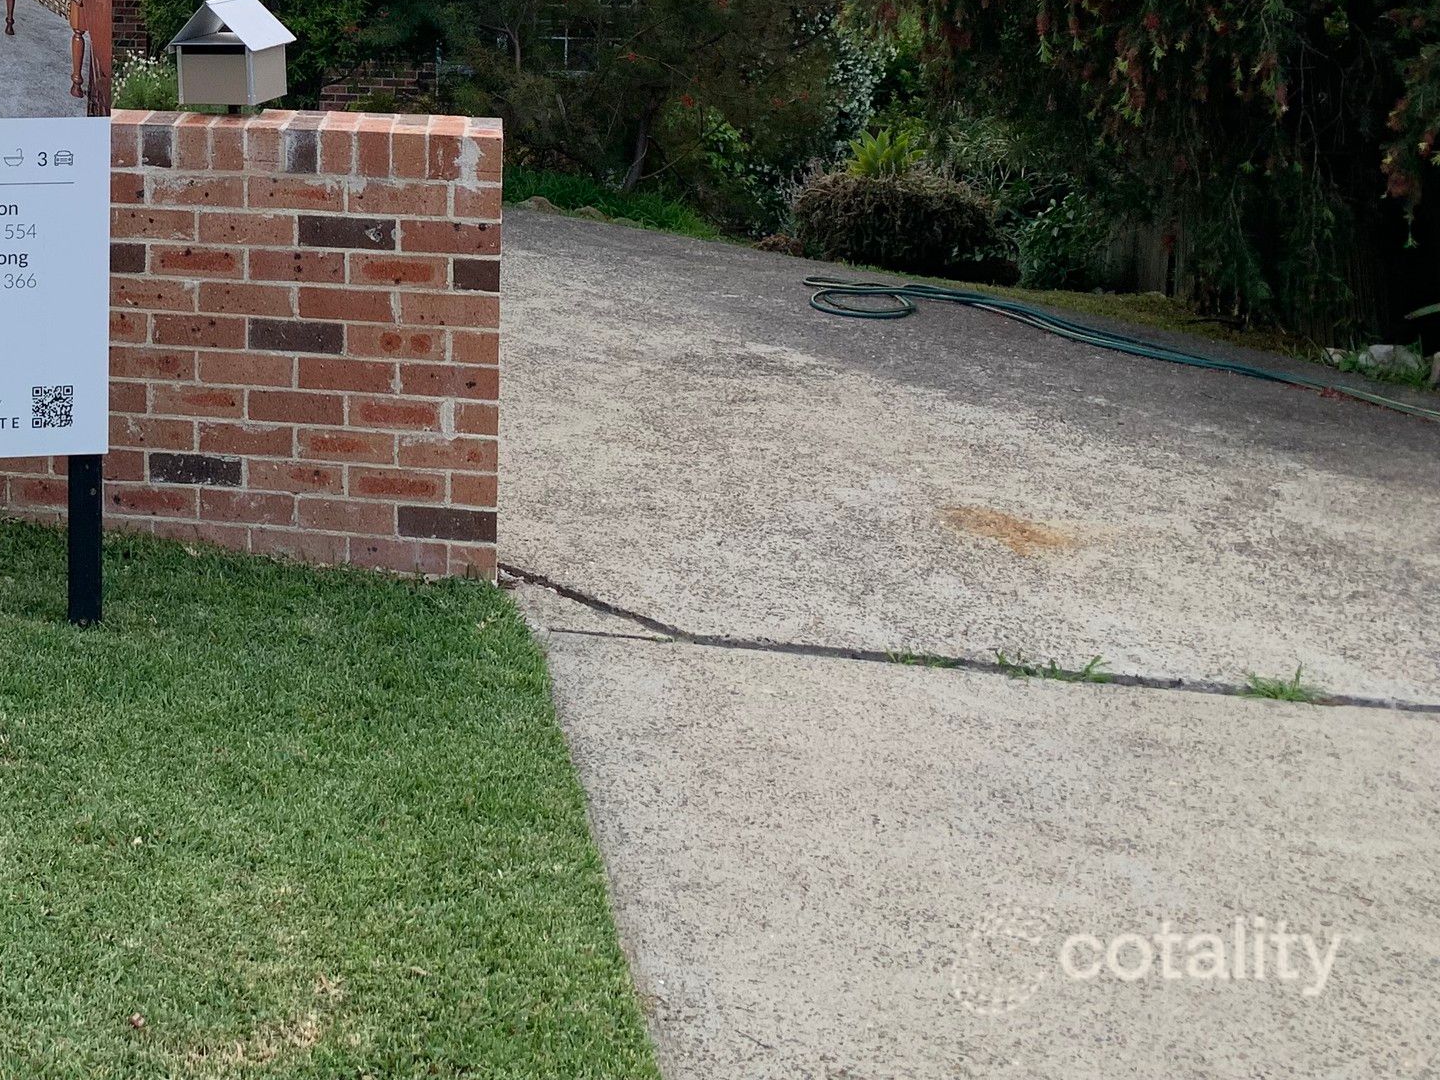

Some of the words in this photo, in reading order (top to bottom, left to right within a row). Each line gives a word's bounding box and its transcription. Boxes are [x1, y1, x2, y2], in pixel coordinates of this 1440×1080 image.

[37, 151, 48, 167] 3
[4, 223, 38, 240] 554
[3, 272, 37, 290] 366
